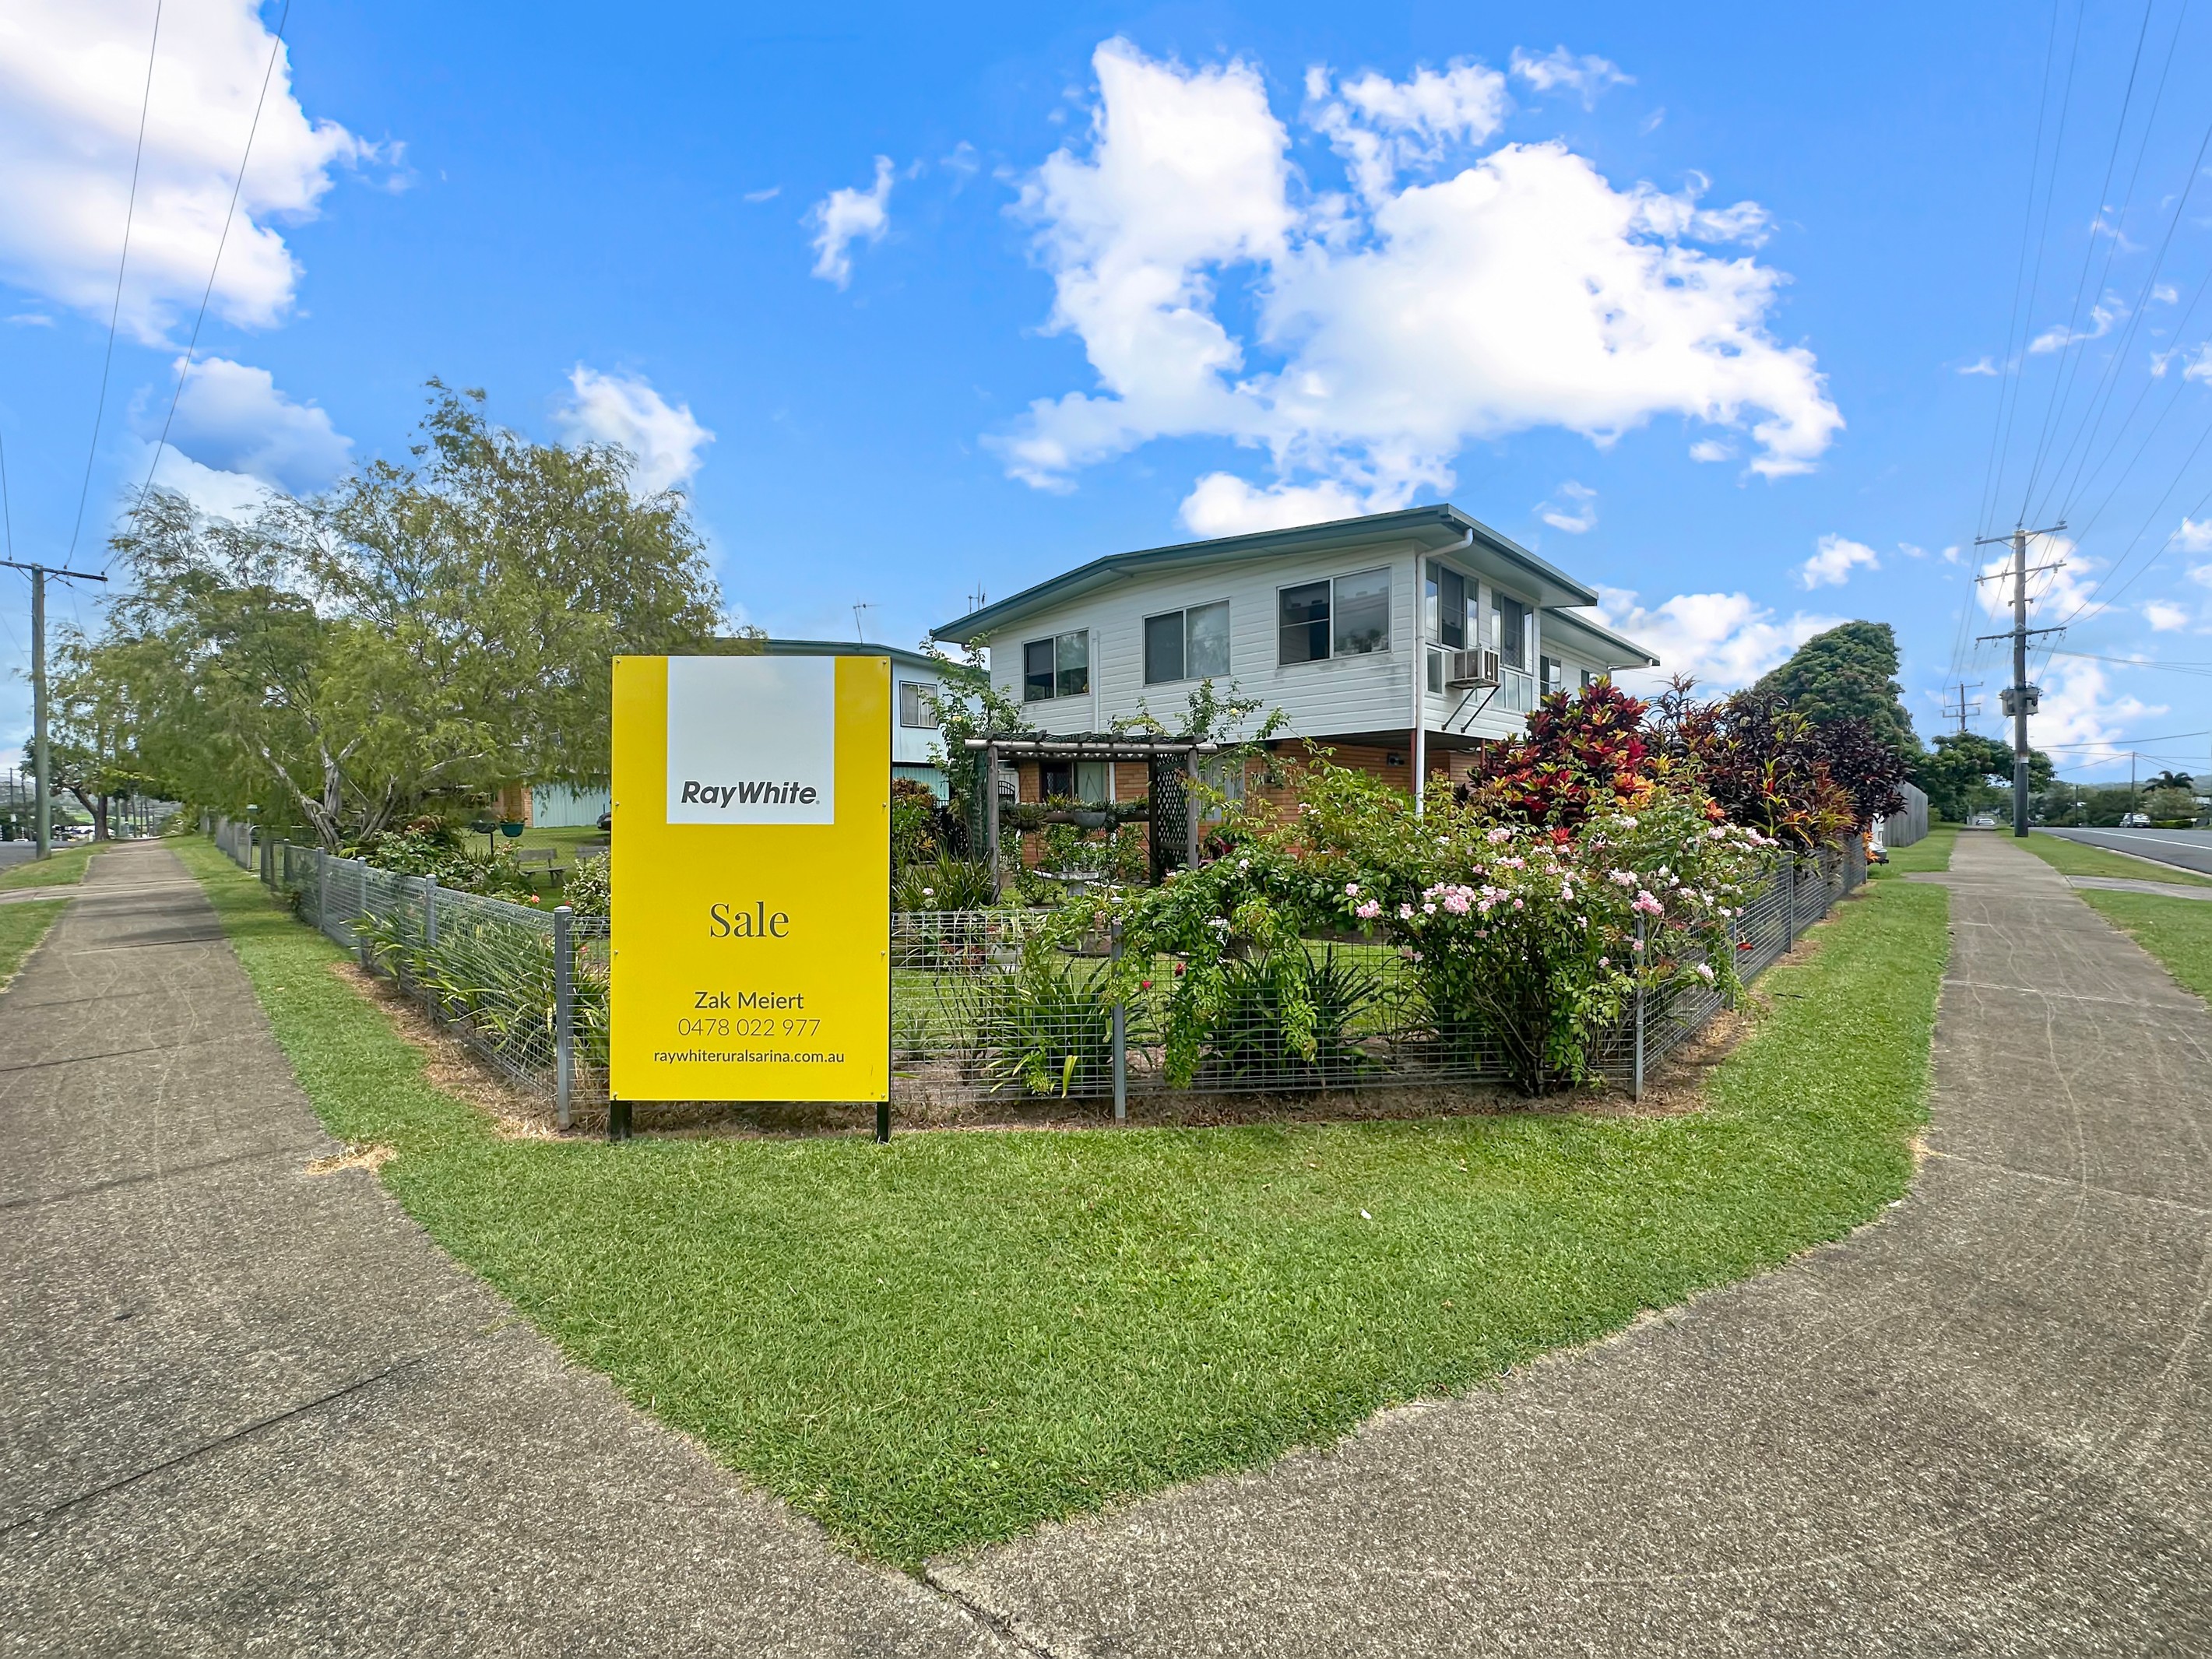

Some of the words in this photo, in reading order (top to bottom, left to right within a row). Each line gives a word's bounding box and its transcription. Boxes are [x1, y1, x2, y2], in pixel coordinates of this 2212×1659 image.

[709, 901, 789, 938] Sale
[695, 991, 730, 1010] Zak
[738, 991, 804, 1010] Meiert
[677, 1018, 730, 1036] 0478
[737, 1018, 775, 1036] 022
[782, 1018, 821, 1036] 977
[653, 1049, 844, 1064] raywhiteruralsarina.com.au
